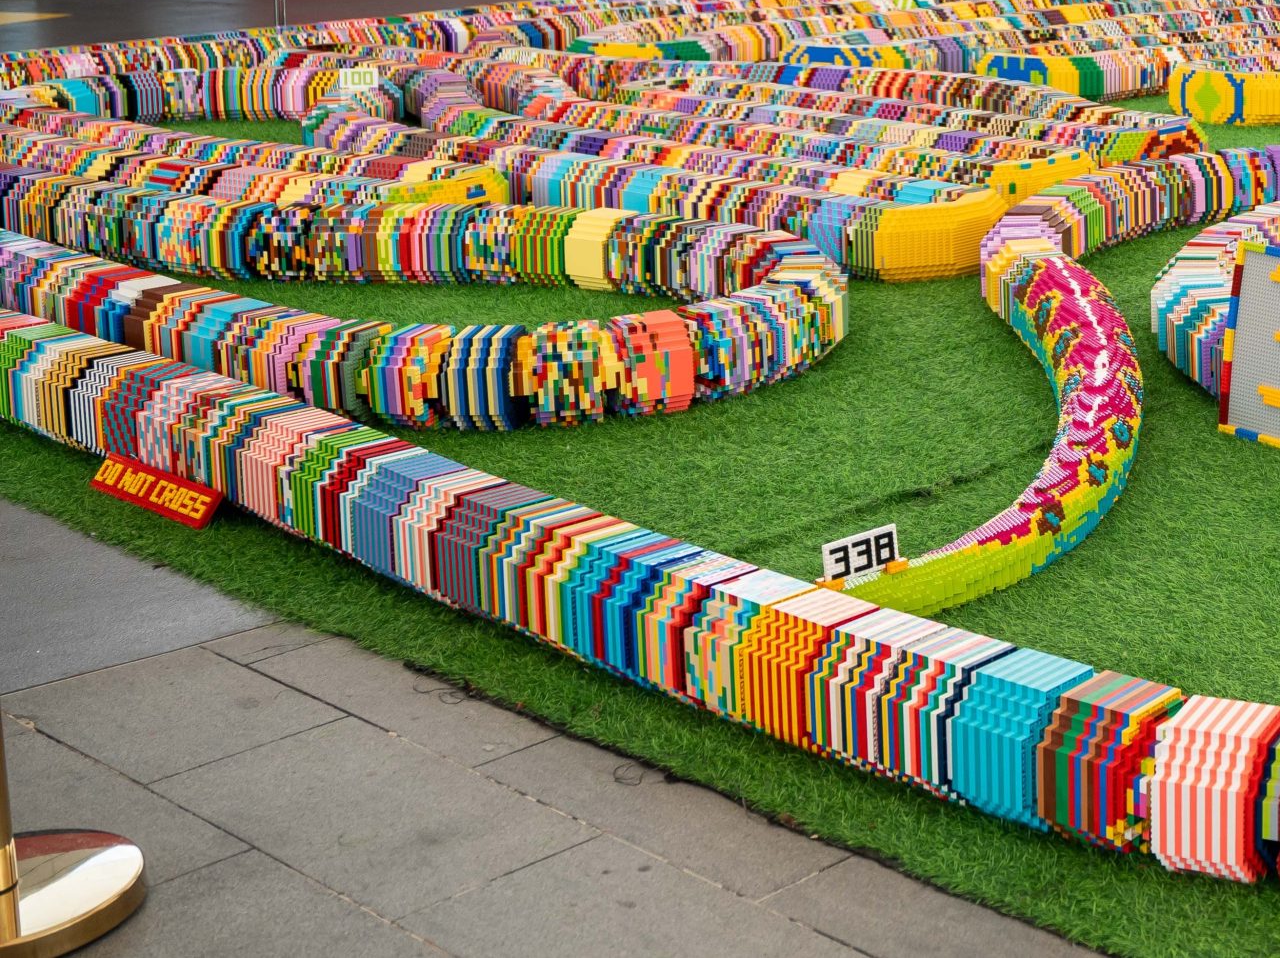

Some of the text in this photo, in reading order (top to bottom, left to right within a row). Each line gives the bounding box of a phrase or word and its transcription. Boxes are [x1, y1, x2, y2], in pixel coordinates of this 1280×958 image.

[343, 71, 374, 86] 100
[94, 458, 212, 519] DO NOT CROSS
[829, 530, 896, 580] 338
